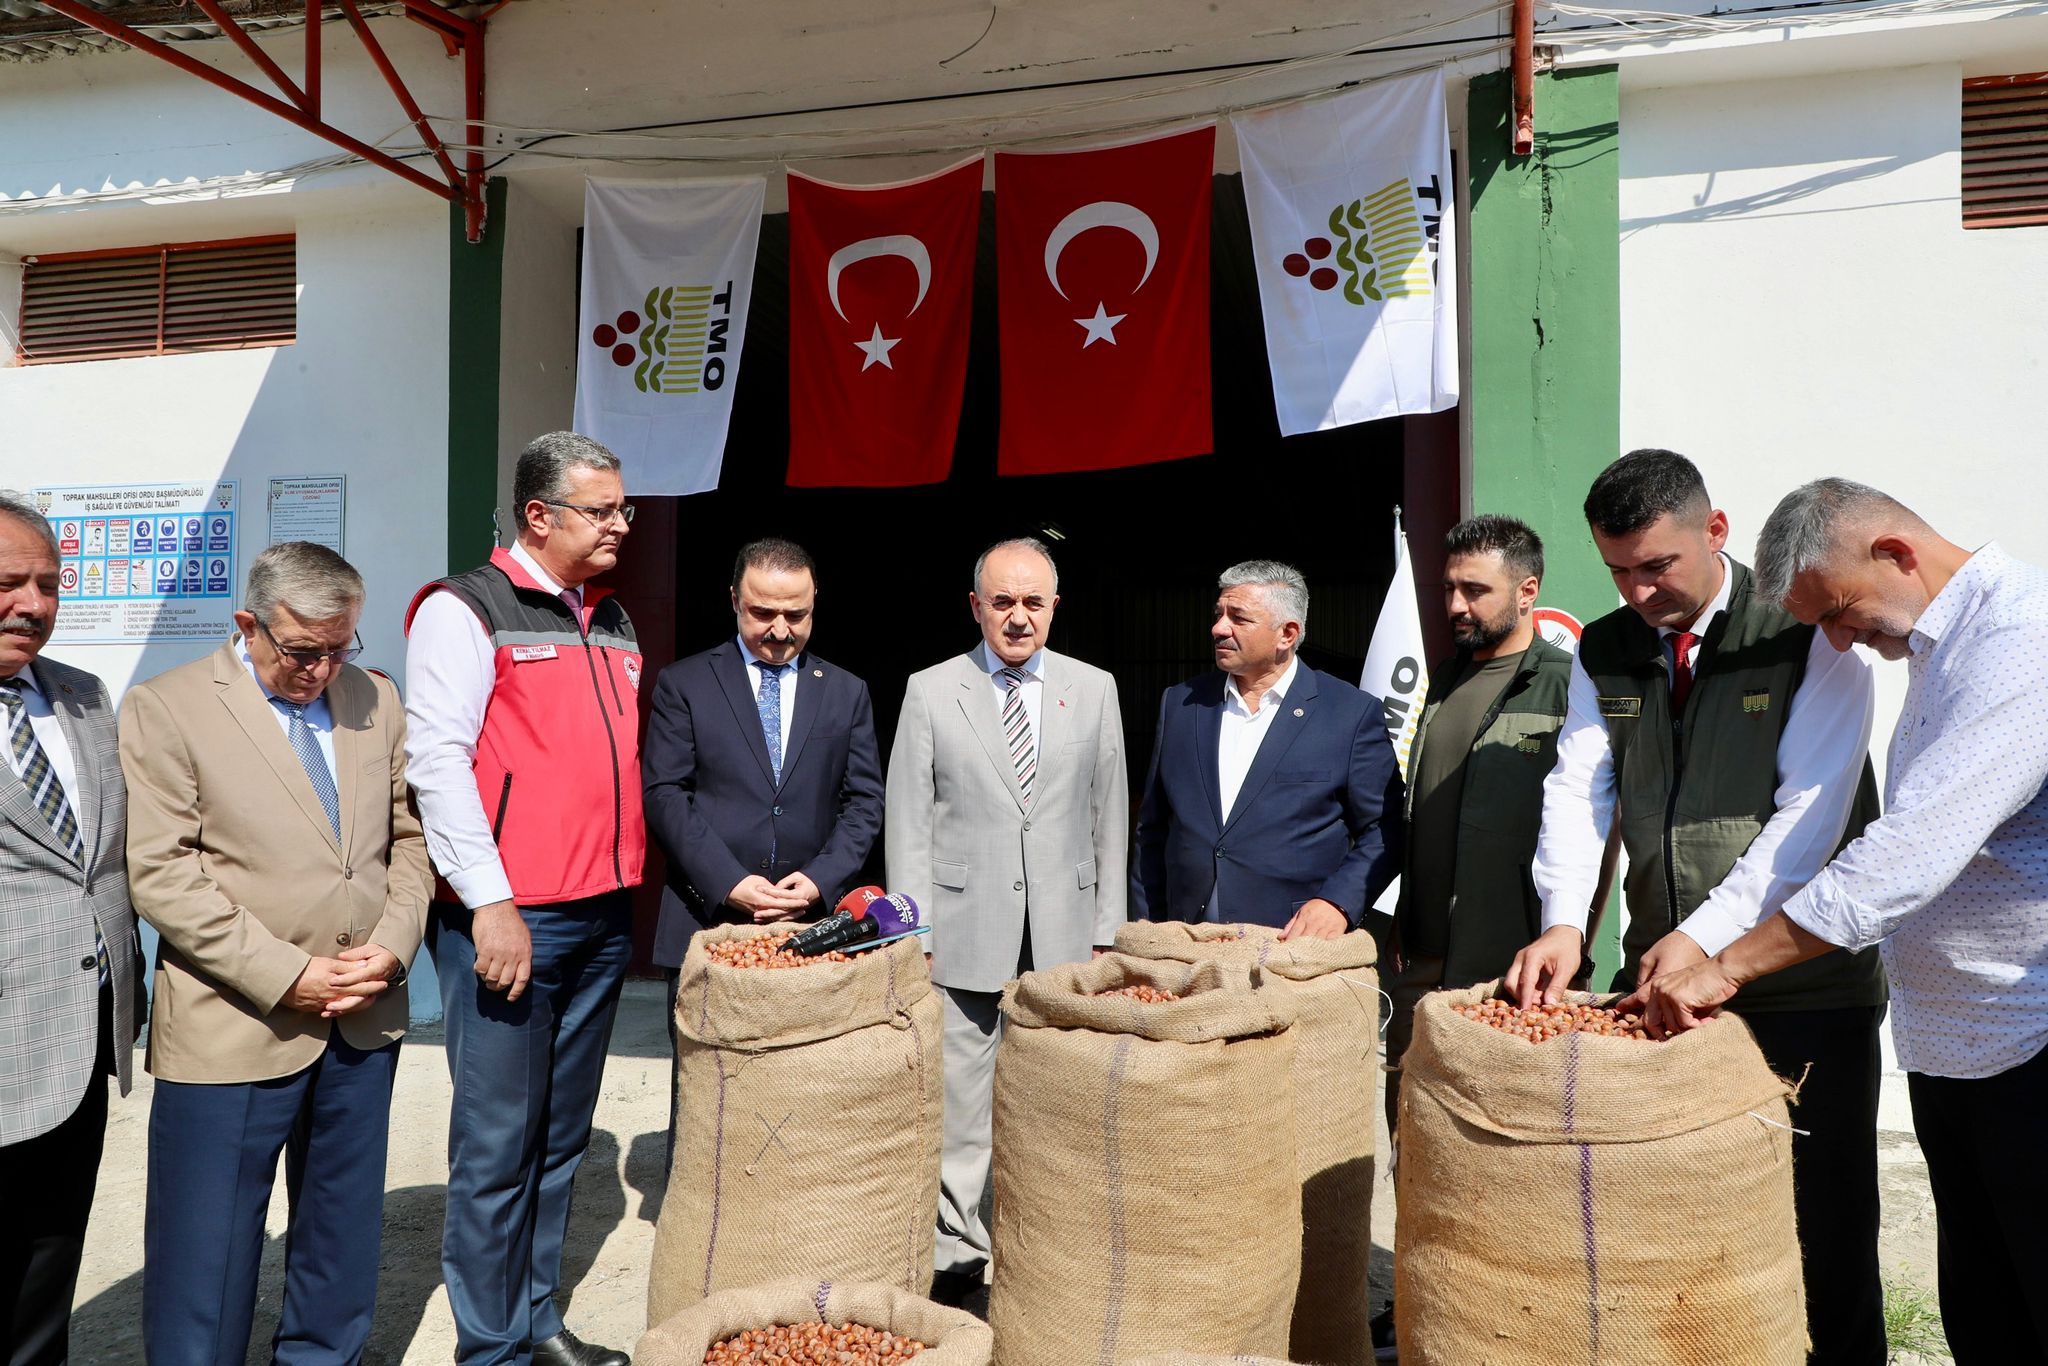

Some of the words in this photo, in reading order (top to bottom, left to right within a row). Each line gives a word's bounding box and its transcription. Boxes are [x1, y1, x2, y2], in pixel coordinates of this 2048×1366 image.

[1417, 174, 1441, 288] TM
[703, 280, 733, 391] TMO
[84, 502, 90, 512] İŞ
[92, 502, 114, 510] SAĞLIĞI
[124, 500, 154, 510] GÜVENLİĞİ
[154, 500, 180, 508] TALİMATI
[138, 490, 154, 498] ORDU
[156, 488, 204, 500] BAŞMÜDÜRLÜĞÜ
[62, 574, 74, 584] 10
[1383, 656, 1420, 740] MO
